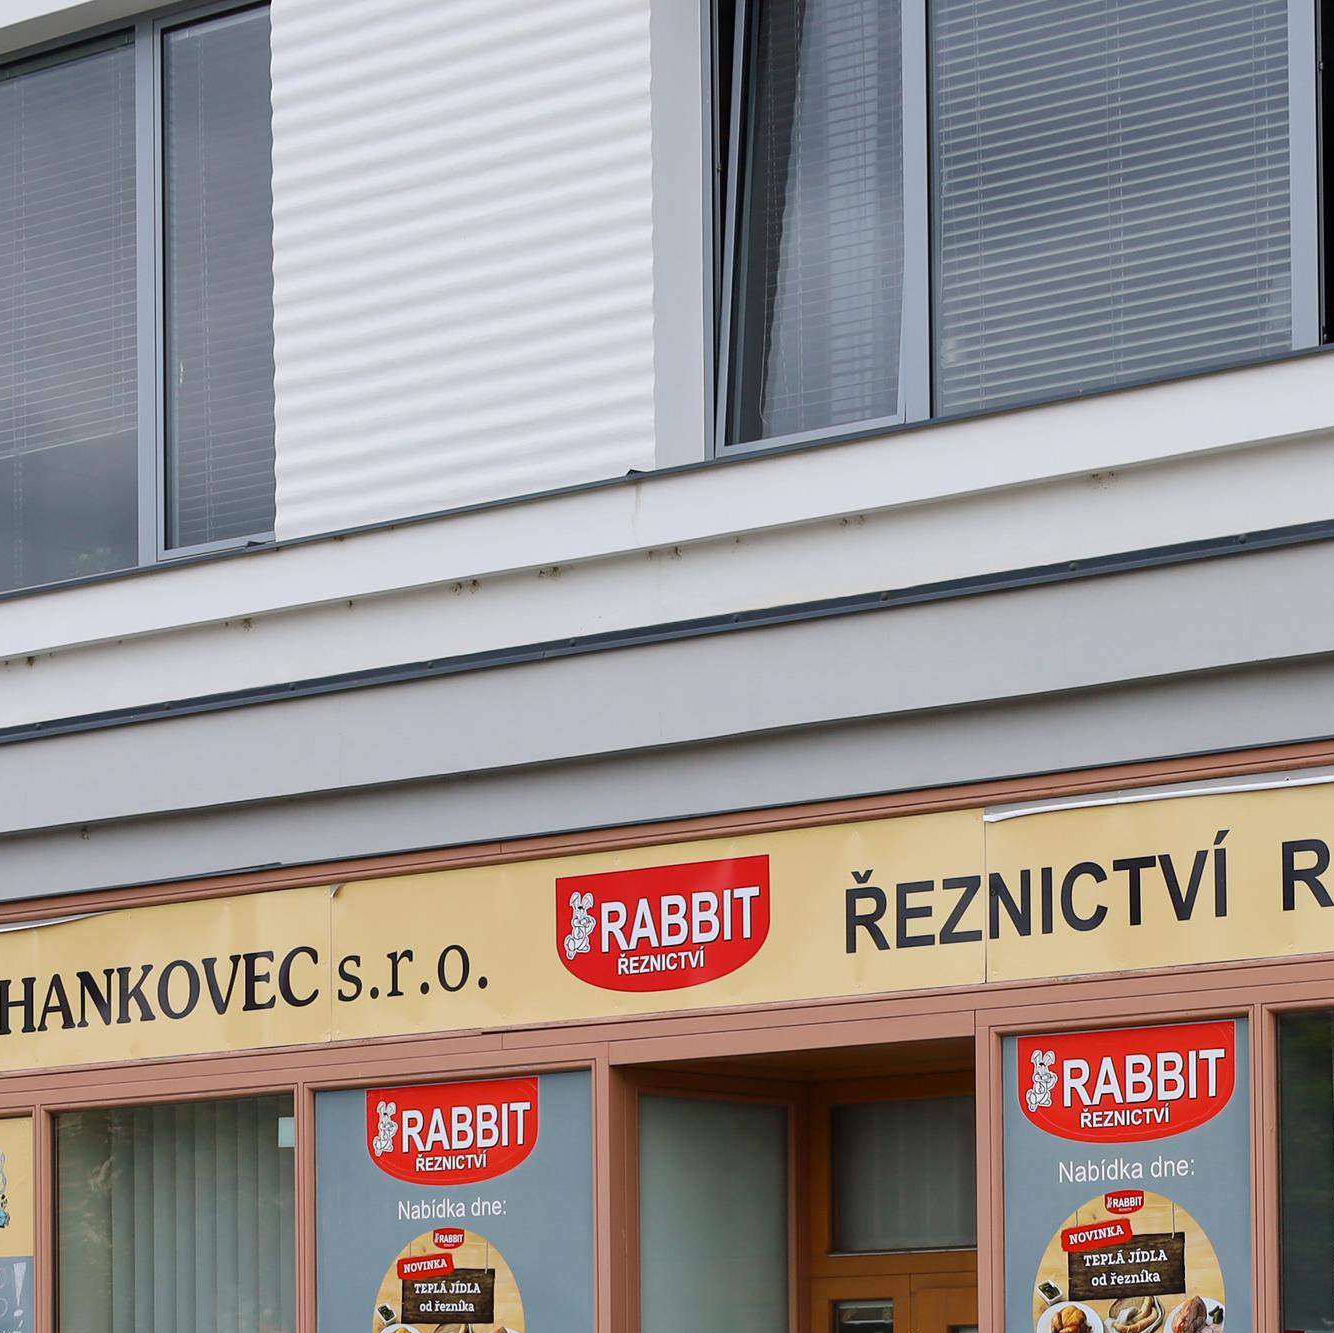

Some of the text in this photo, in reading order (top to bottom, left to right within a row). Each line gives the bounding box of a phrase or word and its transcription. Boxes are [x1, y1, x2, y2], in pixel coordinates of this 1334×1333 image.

[843, 829, 1230, 954] ŘEZNICTVÍ
[600, 886, 761, 954] RABBIT
[337, 944, 488, 1002] s.r.o.
[617, 948, 706, 976] ŘEZNICTVÍ
[1063, 1048, 1226, 1107] RABBIT
[1080, 1104, 1170, 1128] ŘEZNICTVÍ
[402, 1102, 531, 1153] RABBIT
[415, 1150, 488, 1172] ŘEZNICTVÍ
[1059, 1155, 1195, 1183] Nabídka dne:
[398, 1197, 507, 1220] Nabídka dne:
[1113, 1196, 1143, 1208] RABBIT
[439, 1234, 463, 1243] RABBIT
[1069, 1225, 1124, 1245] NOVINKA
[403, 1258, 447, 1274] NOVINKA
[1083, 1249, 1168, 1267] TEPLÁ JÍDLA
[414, 1280, 482, 1294] TEPLÁ JÍDLA
[1091, 1269, 1161, 1287] od řezníka
[419, 1299, 475, 1313] od řezníka
